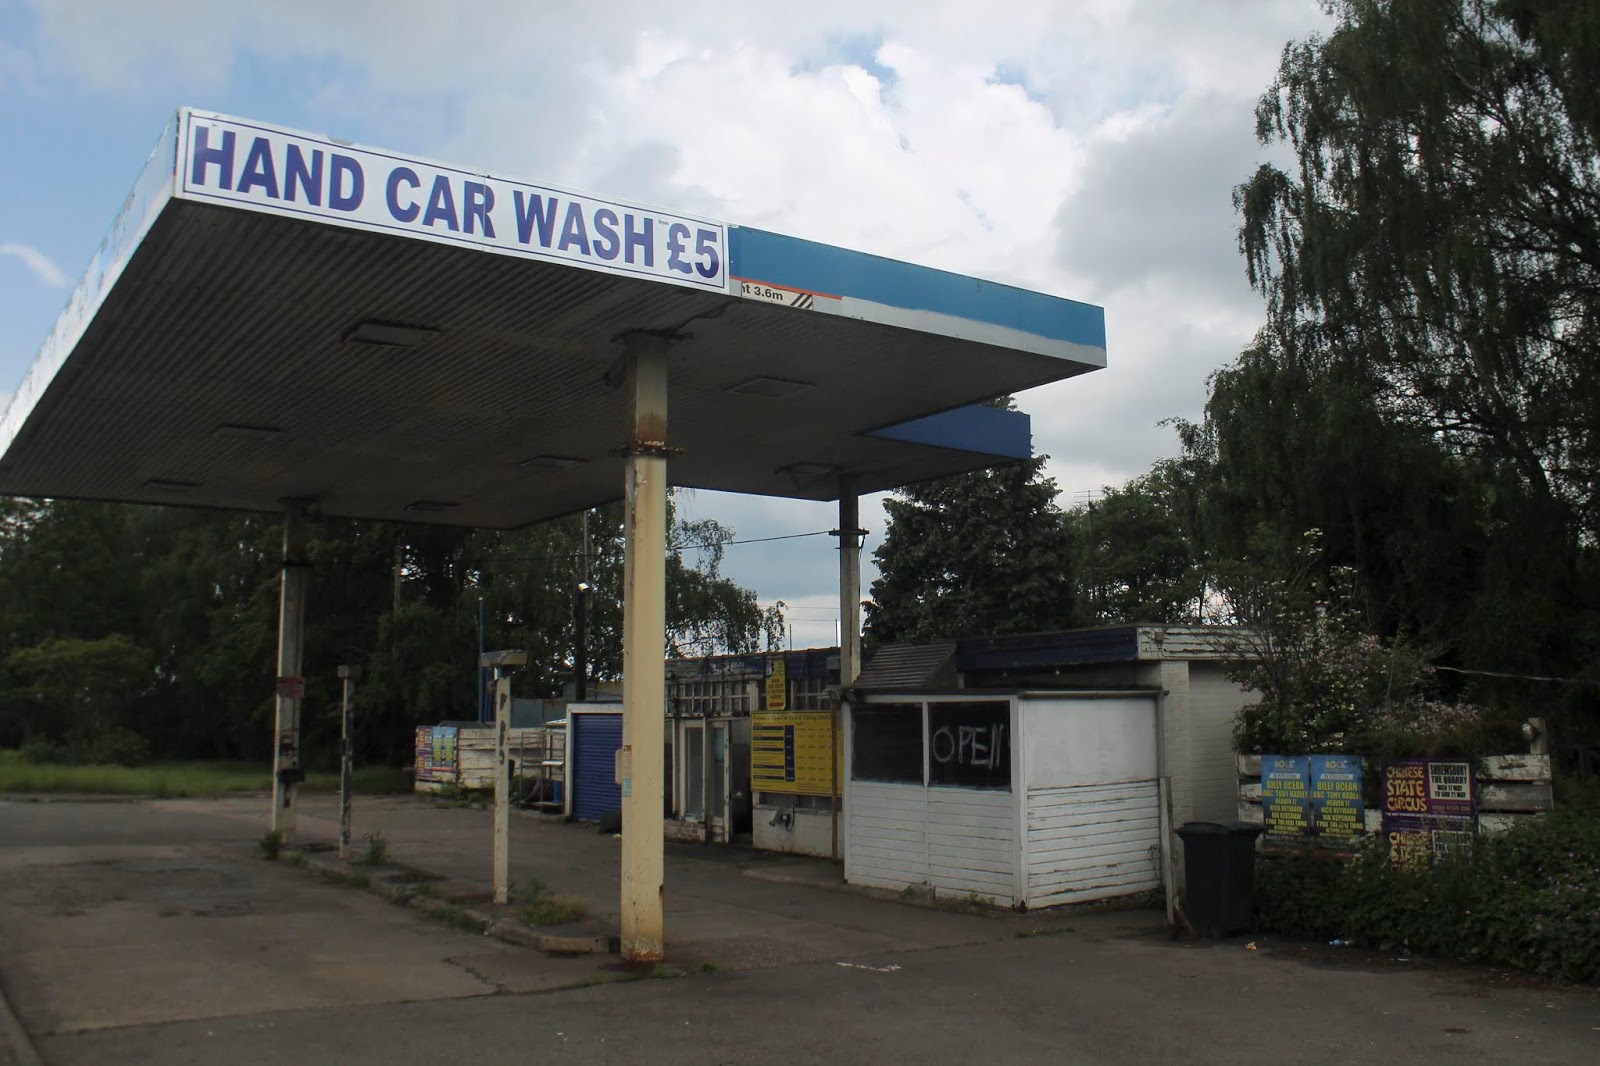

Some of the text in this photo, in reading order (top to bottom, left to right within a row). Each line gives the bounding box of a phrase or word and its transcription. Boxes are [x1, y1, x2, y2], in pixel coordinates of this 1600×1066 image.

[192, 125, 365, 212] HAND
[386, 167, 496, 239] CAR
[513, 190, 654, 268] WASH
[667, 223, 719, 279] £5
[754, 286, 783, 300] 3.6m
[933, 723, 1004, 770] OPEN
[1430, 764, 1467, 776] SHREWSBURY
[1266, 781, 1304, 790] BILLY OCEAN
[1317, 782, 1358, 791] BILLY OCEAN
[1431, 776, 1467, 785] THE QUARRY
[1387, 780, 1425, 797] STATE
